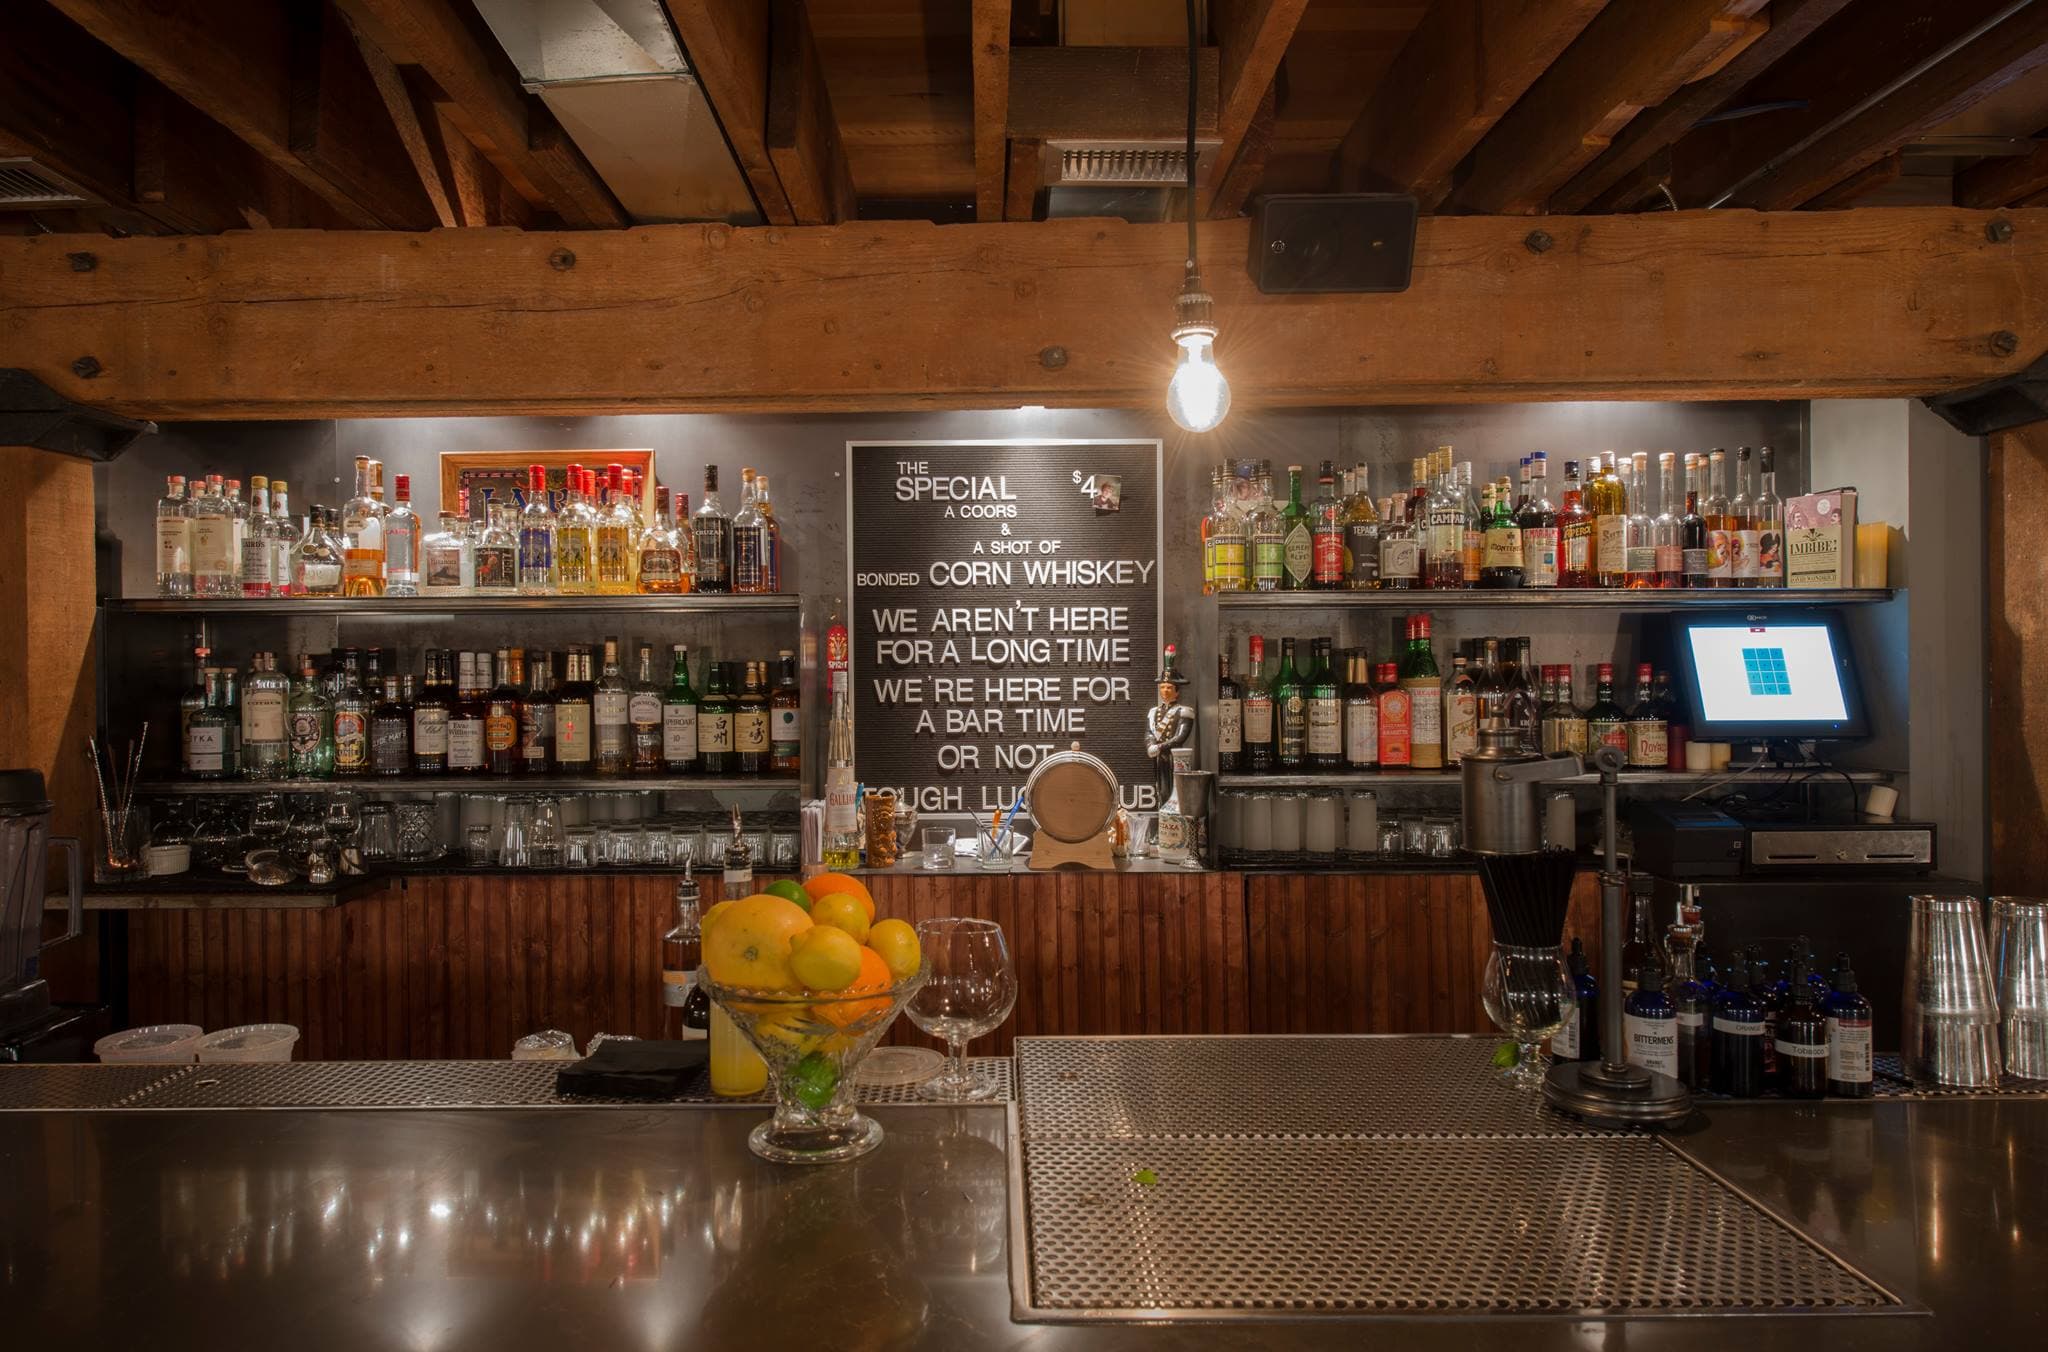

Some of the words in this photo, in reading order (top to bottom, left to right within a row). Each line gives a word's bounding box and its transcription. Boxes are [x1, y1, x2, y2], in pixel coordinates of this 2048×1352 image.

[896, 461, 929, 475] THE
[895, 475, 1017, 502] SPECIAL
[944, 505, 955, 519] A
[960, 504, 1018, 519] COORS
[1000, 522, 1011, 537] &
[1563, 525, 1592, 540] APEROL
[973, 540, 984, 555] A
[990, 540, 1032, 555] SHOT
[1038, 540, 1062, 555] OF
[1789, 539, 1837, 555] IMBIBE!
[856, 573, 920, 587] BONDED
[929, 560, 1012, 587] CORN
[1023, 559, 1156, 586] WHISKEY
[872, 608, 918, 634] WE
[930, 599, 1040, 633] AREN'T
[1049, 606, 1129, 632] HERE
[876, 639, 935, 665] FOR
[939, 639, 961, 664] A
[971, 636, 1051, 664] LONG
[1056, 638, 1130, 663] TIME
[873, 675, 975, 704] WE'RE
[985, 677, 1061, 703] HERE
[1073, 676, 1131, 702] FOR
[915, 709, 936, 734] A
[946, 709, 1004, 734] BAR
[1015, 708, 1086, 733] TIME
[937, 744, 980, 770] OR
[994, 743, 1055, 770] NOT
[1633, 1033, 1674, 1045] BITTERMENS
